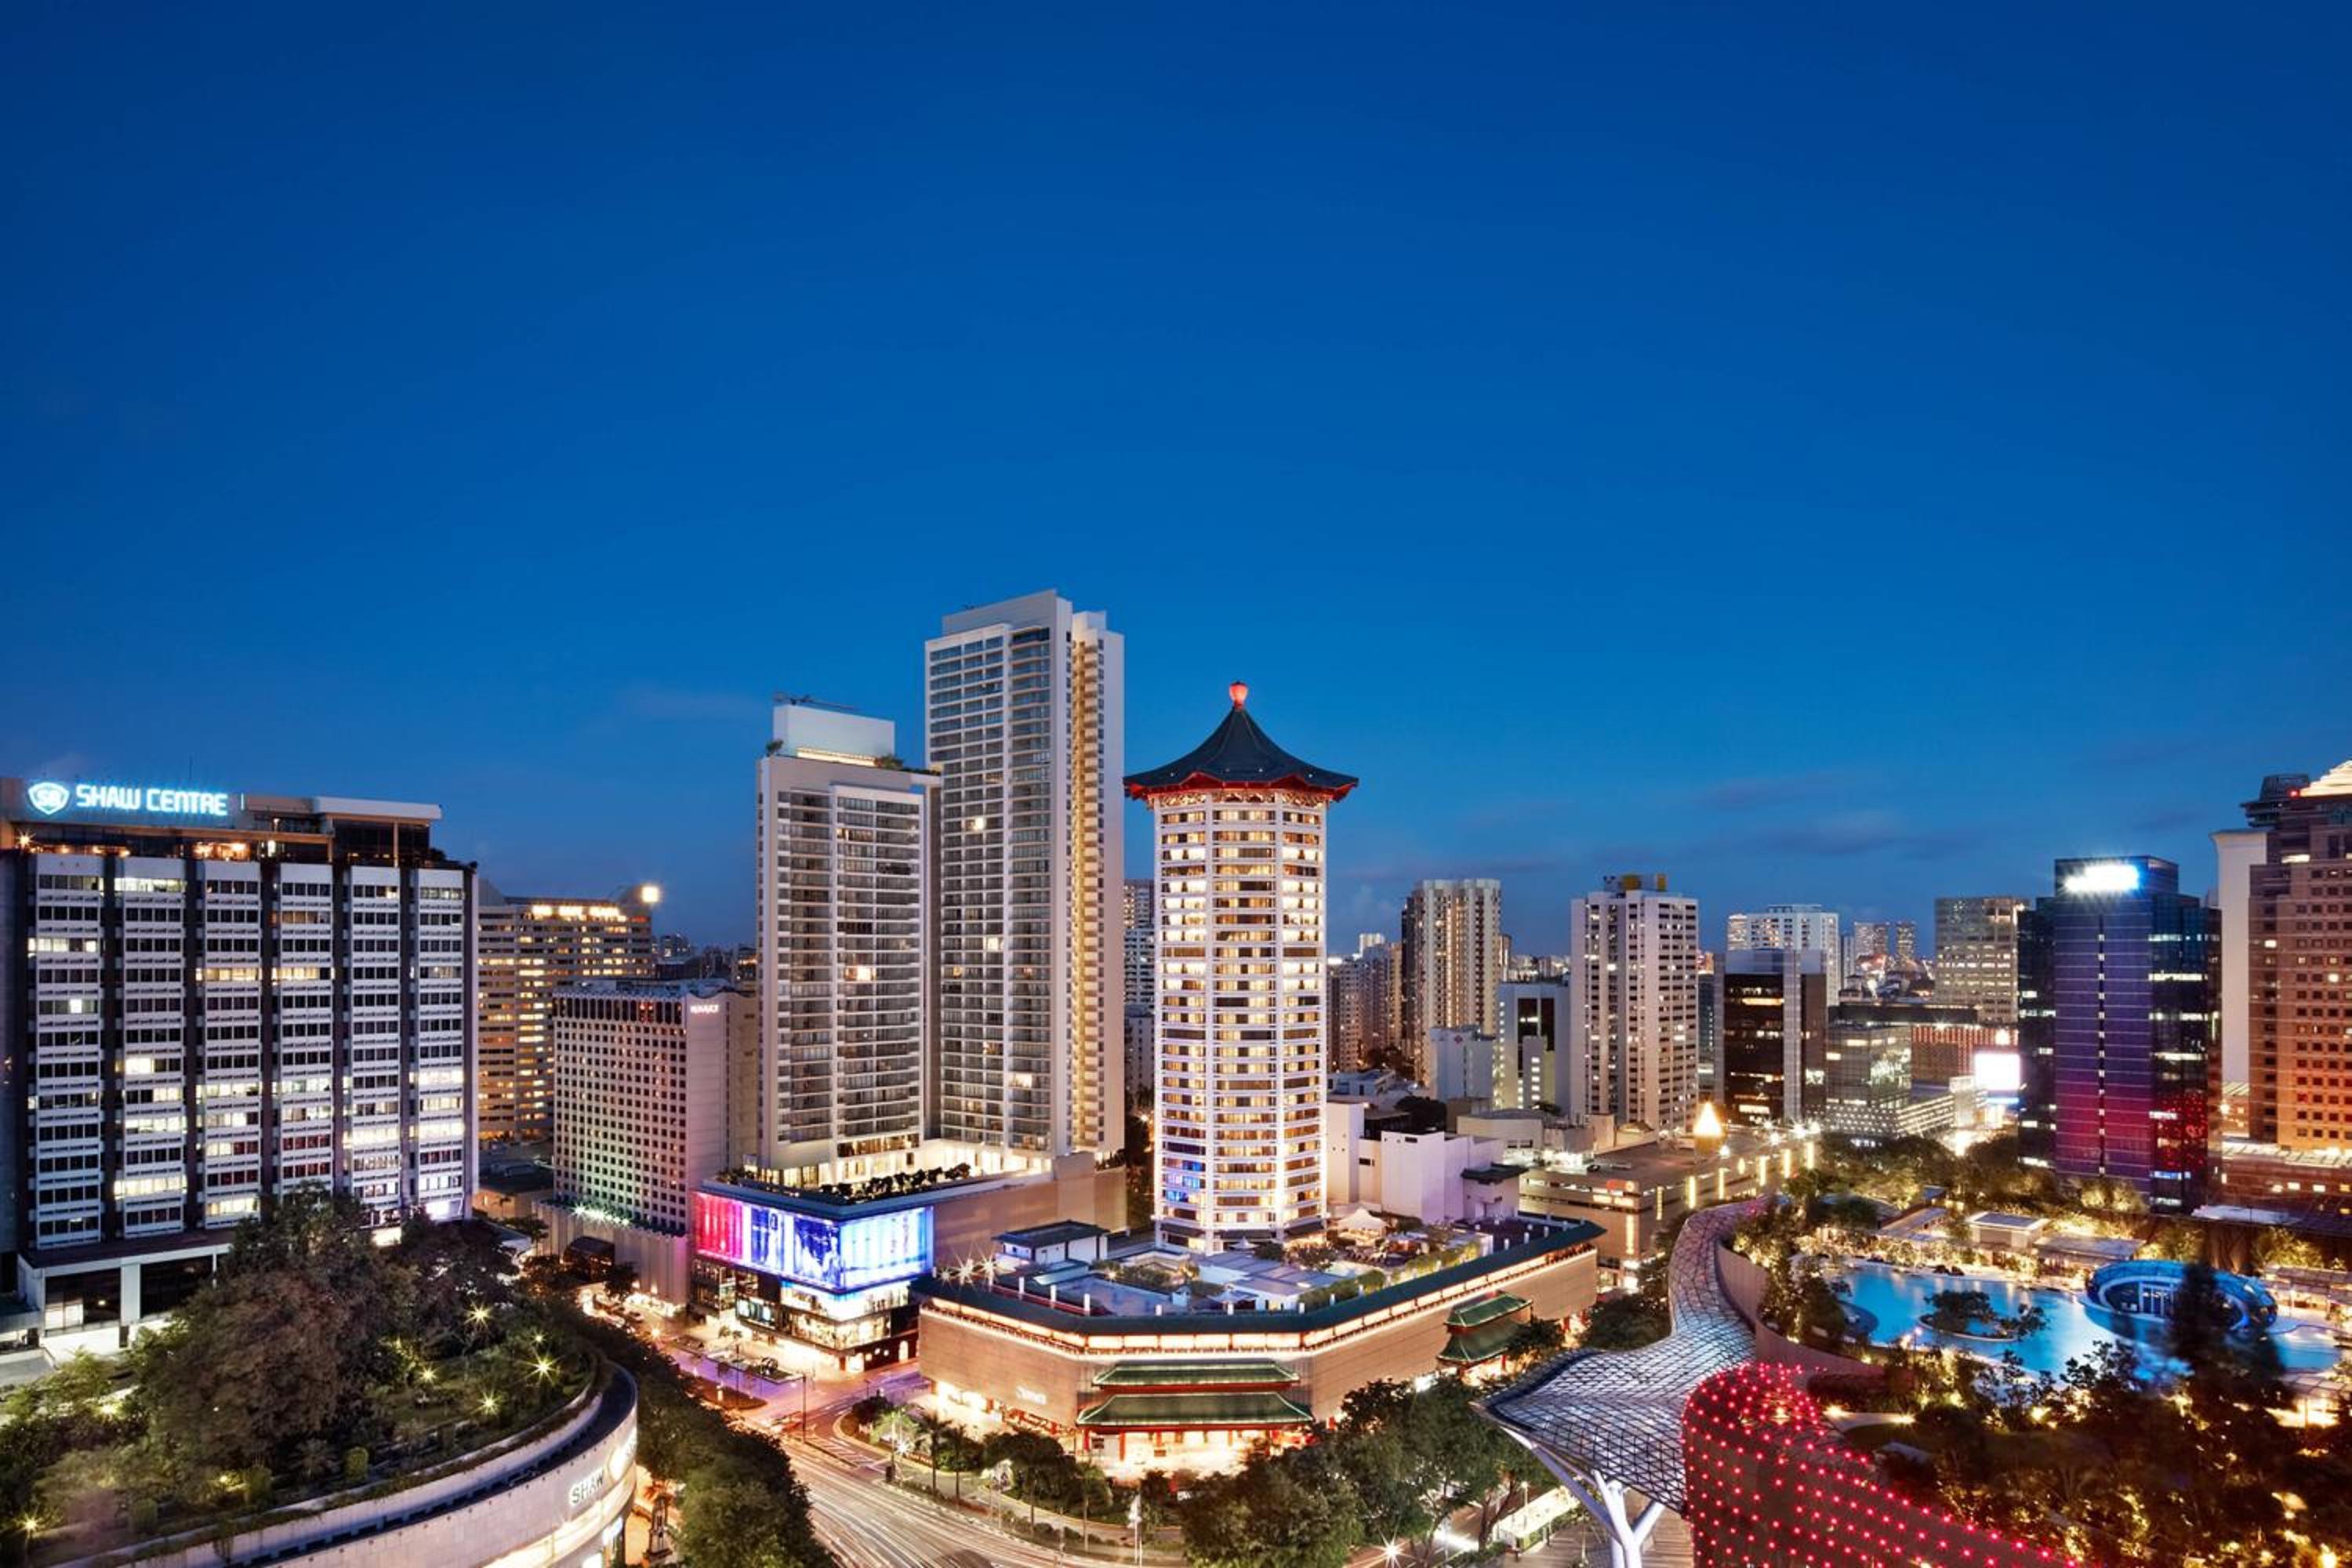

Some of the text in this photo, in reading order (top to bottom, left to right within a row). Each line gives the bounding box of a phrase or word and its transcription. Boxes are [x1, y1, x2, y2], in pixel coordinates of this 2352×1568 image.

[76, 785, 228, 816] SHAW CENTRE
[569, 1468, 604, 1505] SHAW
